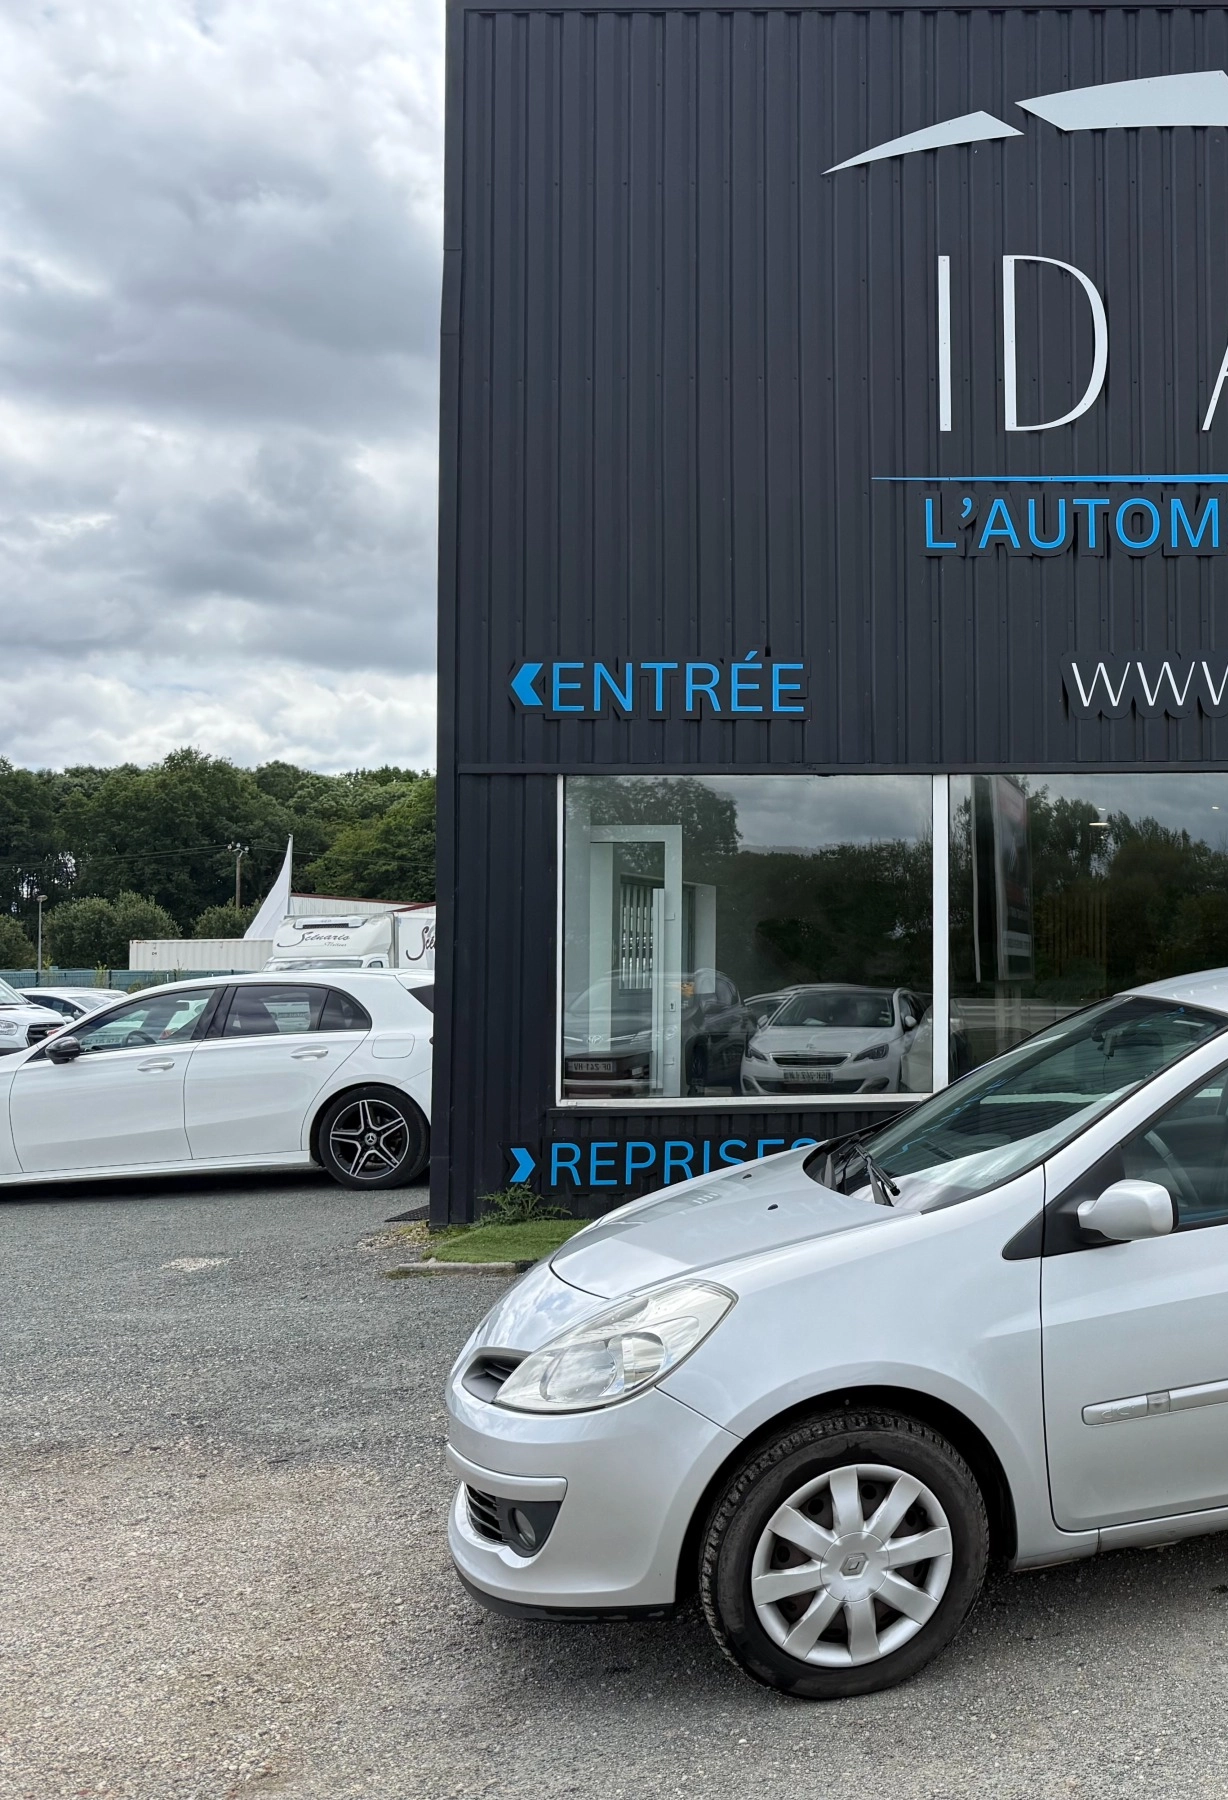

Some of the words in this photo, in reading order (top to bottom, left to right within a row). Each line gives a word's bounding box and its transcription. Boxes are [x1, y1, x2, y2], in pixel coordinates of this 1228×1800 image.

[936, 253, 1108, 432] ID
[552, 650, 805, 712] ENTRÉE
[550, 1138, 818, 1186] REPRIS
